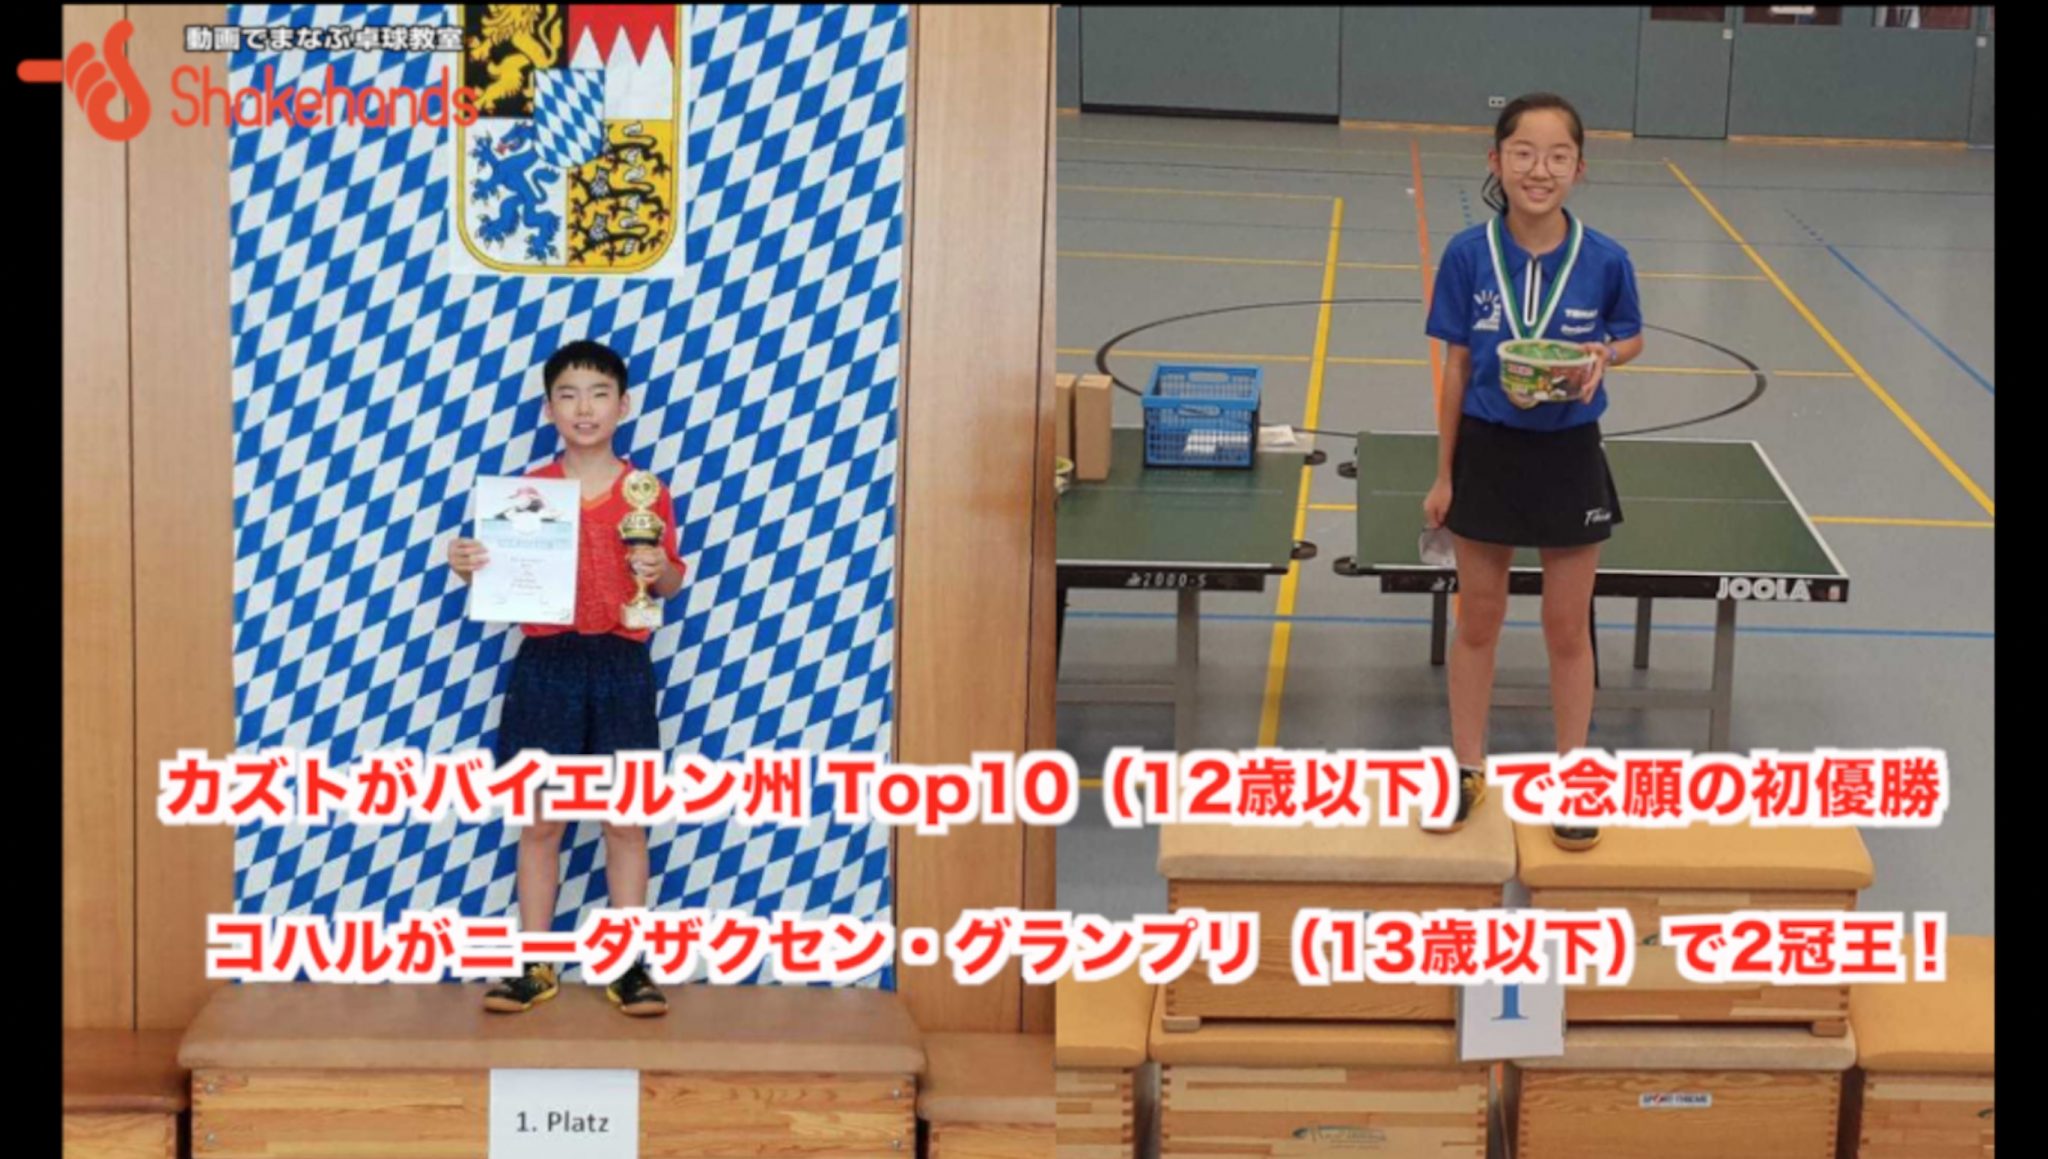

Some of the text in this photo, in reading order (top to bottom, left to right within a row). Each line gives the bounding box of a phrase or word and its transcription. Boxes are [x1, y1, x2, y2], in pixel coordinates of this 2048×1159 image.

[1716, 576, 1812, 601] JOOLA
[516, 1109, 610, 1133] 1. Platz
